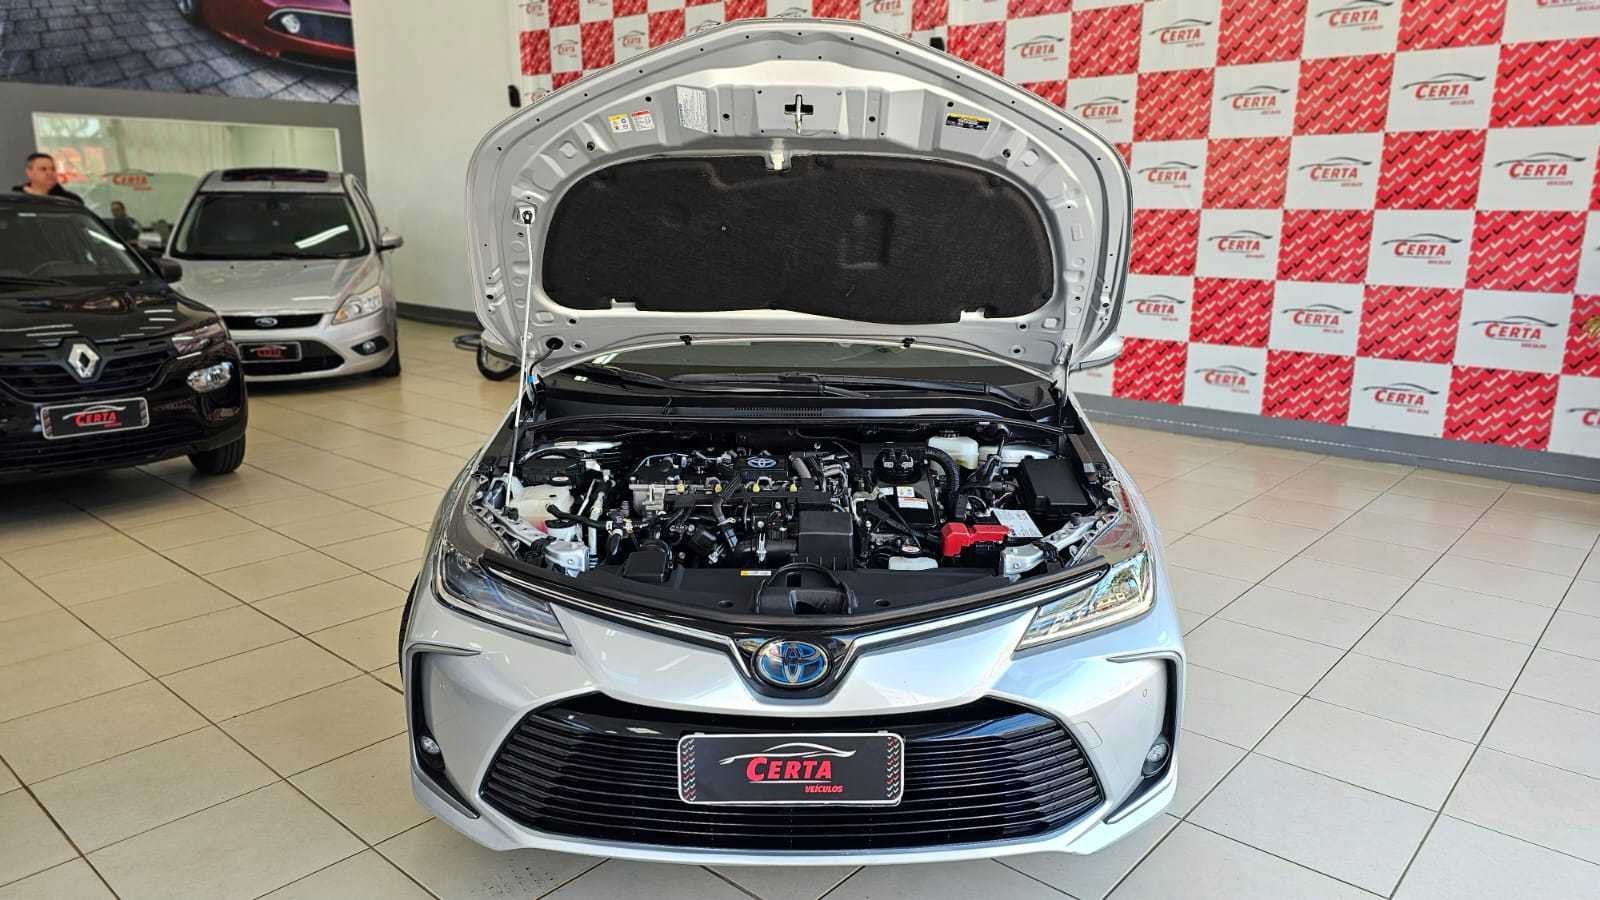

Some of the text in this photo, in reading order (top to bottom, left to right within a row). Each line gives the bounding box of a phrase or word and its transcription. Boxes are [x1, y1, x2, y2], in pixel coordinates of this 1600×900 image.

[1329, 9, 1379, 26] CERTA
[1160, 28, 1201, 44] CERTA
[1021, 43, 1056, 58] CERTA
[1415, 82, 1470, 99] CERTA
[1232, 95, 1277, 109] CERTA
[1082, 104, 1120, 118] CERTA
[1148, 169, 1187, 182] CERTA
[1310, 165, 1358, 180] CERTA
[1509, 161, 1568, 178] CERTA
[1218, 238, 1260, 251] CERTA
[1394, 241, 1446, 256] CERTA
[1136, 300, 1175, 314] CERTA
[1293, 310, 1340, 325] CERTA
[1485, 322, 1542, 339] CERTA
[1205, 370, 1246, 385] CERTA
[1375, 389, 1425, 405] CERTA
[747, 757, 832, 781] CERTA
[805, 783, 844, 793] VEÍCULOS
